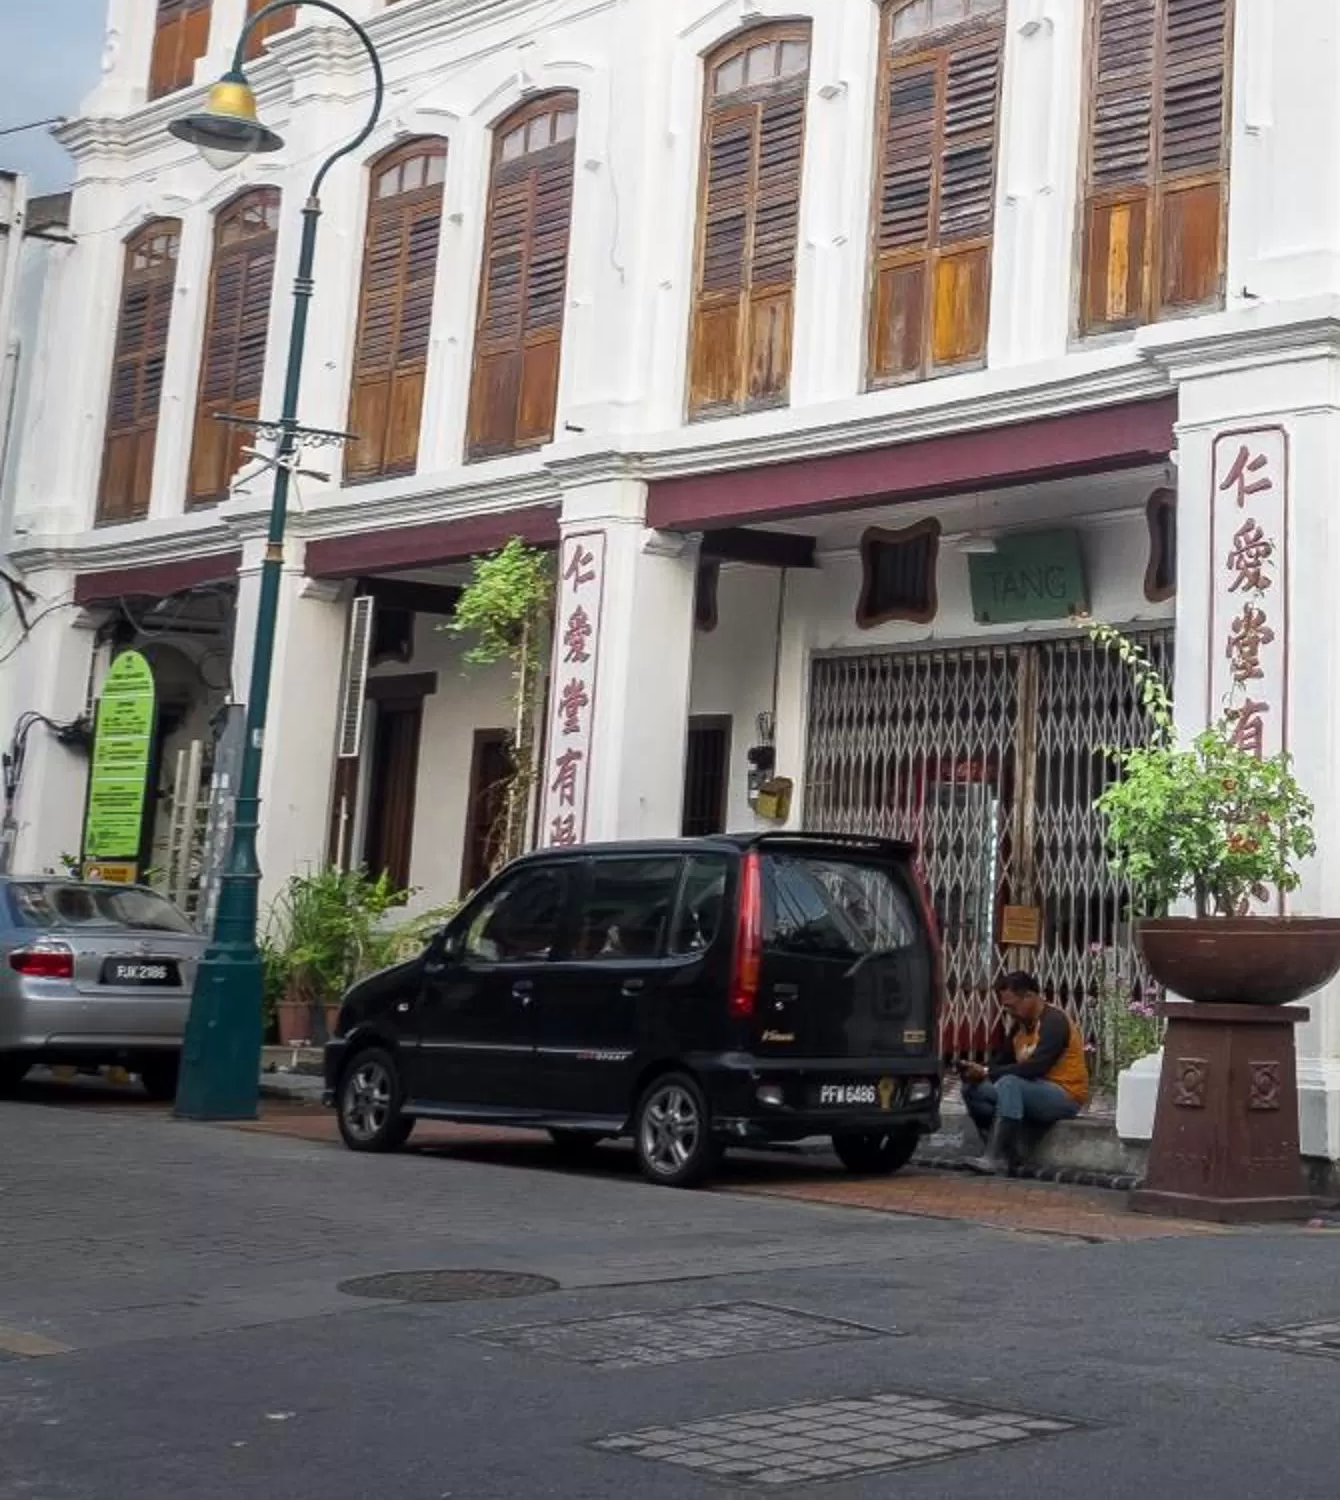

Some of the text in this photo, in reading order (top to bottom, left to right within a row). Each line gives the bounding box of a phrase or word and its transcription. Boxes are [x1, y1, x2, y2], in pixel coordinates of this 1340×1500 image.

[982, 565, 1067, 606] TANG
[1220, 444, 1275, 915] 仁愛堂有
